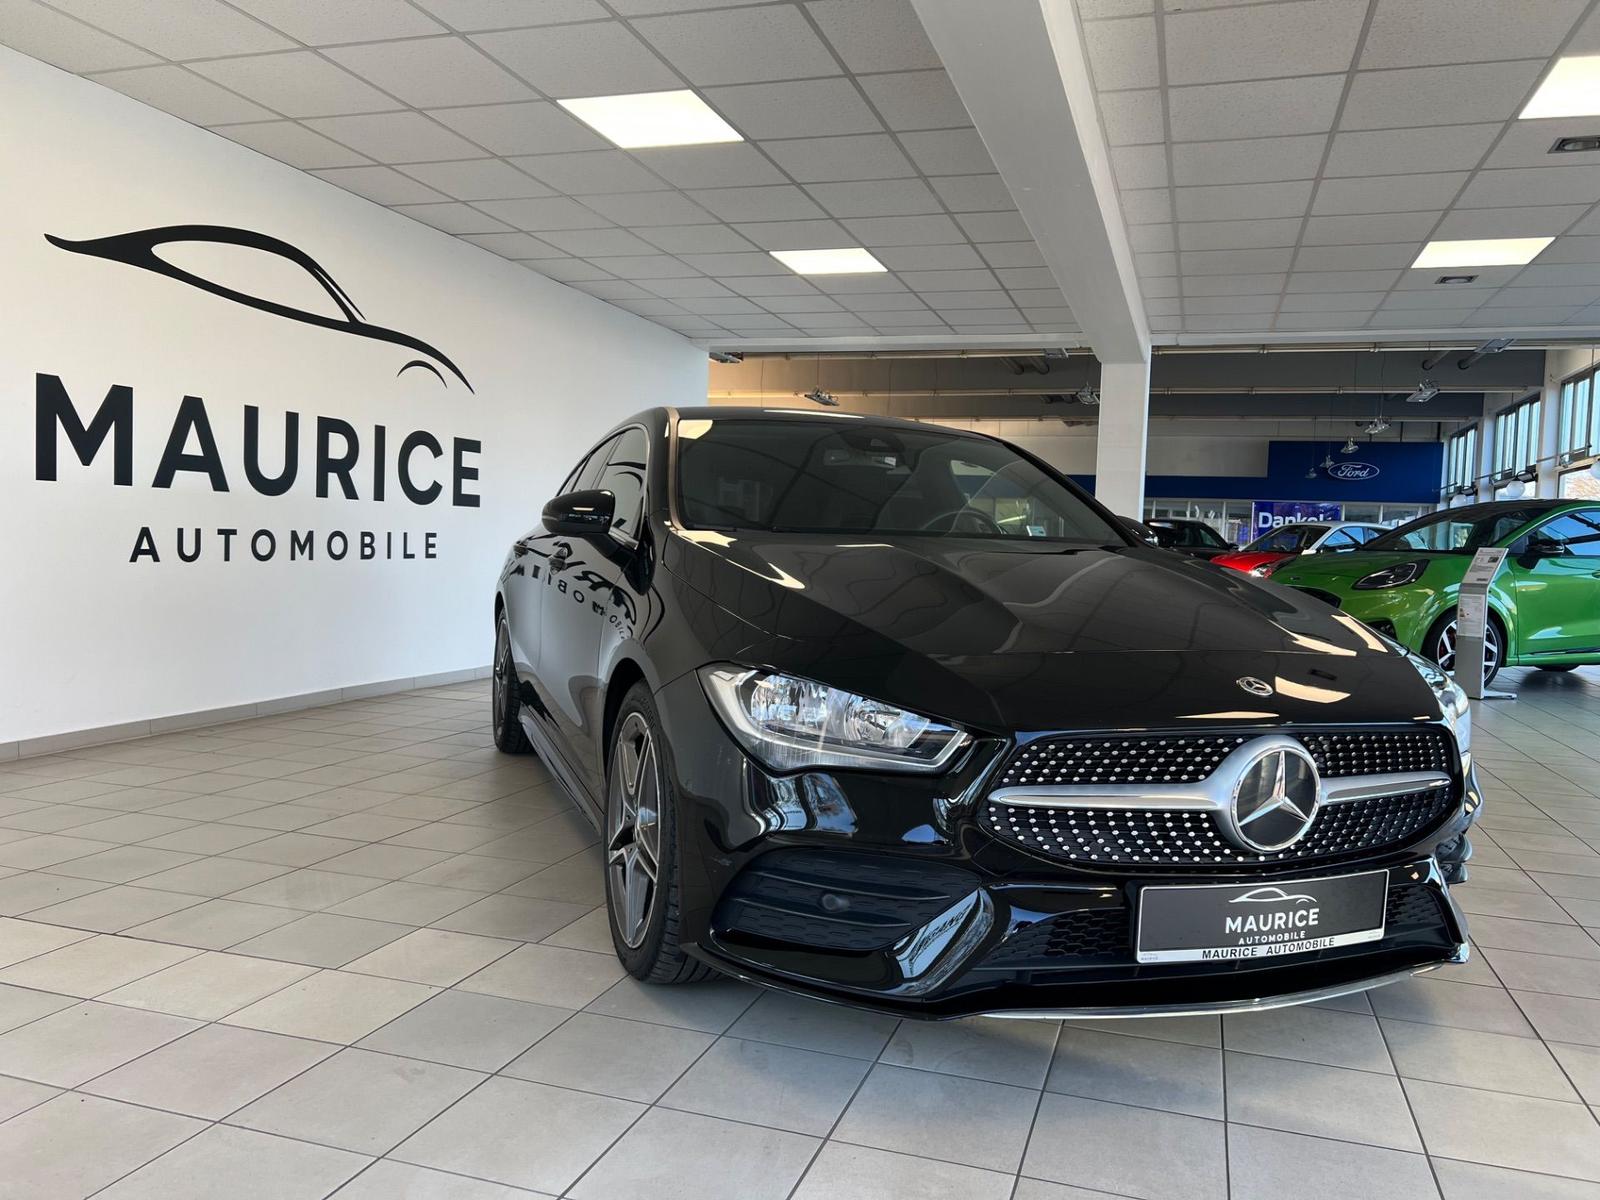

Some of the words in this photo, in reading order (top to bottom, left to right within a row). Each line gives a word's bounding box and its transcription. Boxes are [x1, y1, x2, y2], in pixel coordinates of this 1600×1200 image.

[35, 372, 482, 508] MAURICE
[1337, 464, 1370, 477] Ford
[129, 526, 438, 563] AUTOMOBILE
[1225, 908, 1320, 934] MAURICE
[1201, 947, 1257, 960] MAURICE
[1266, 937, 1335, 955] AUTOMOBILE
[1238, 931, 1306, 945] AUTOMOBILE
